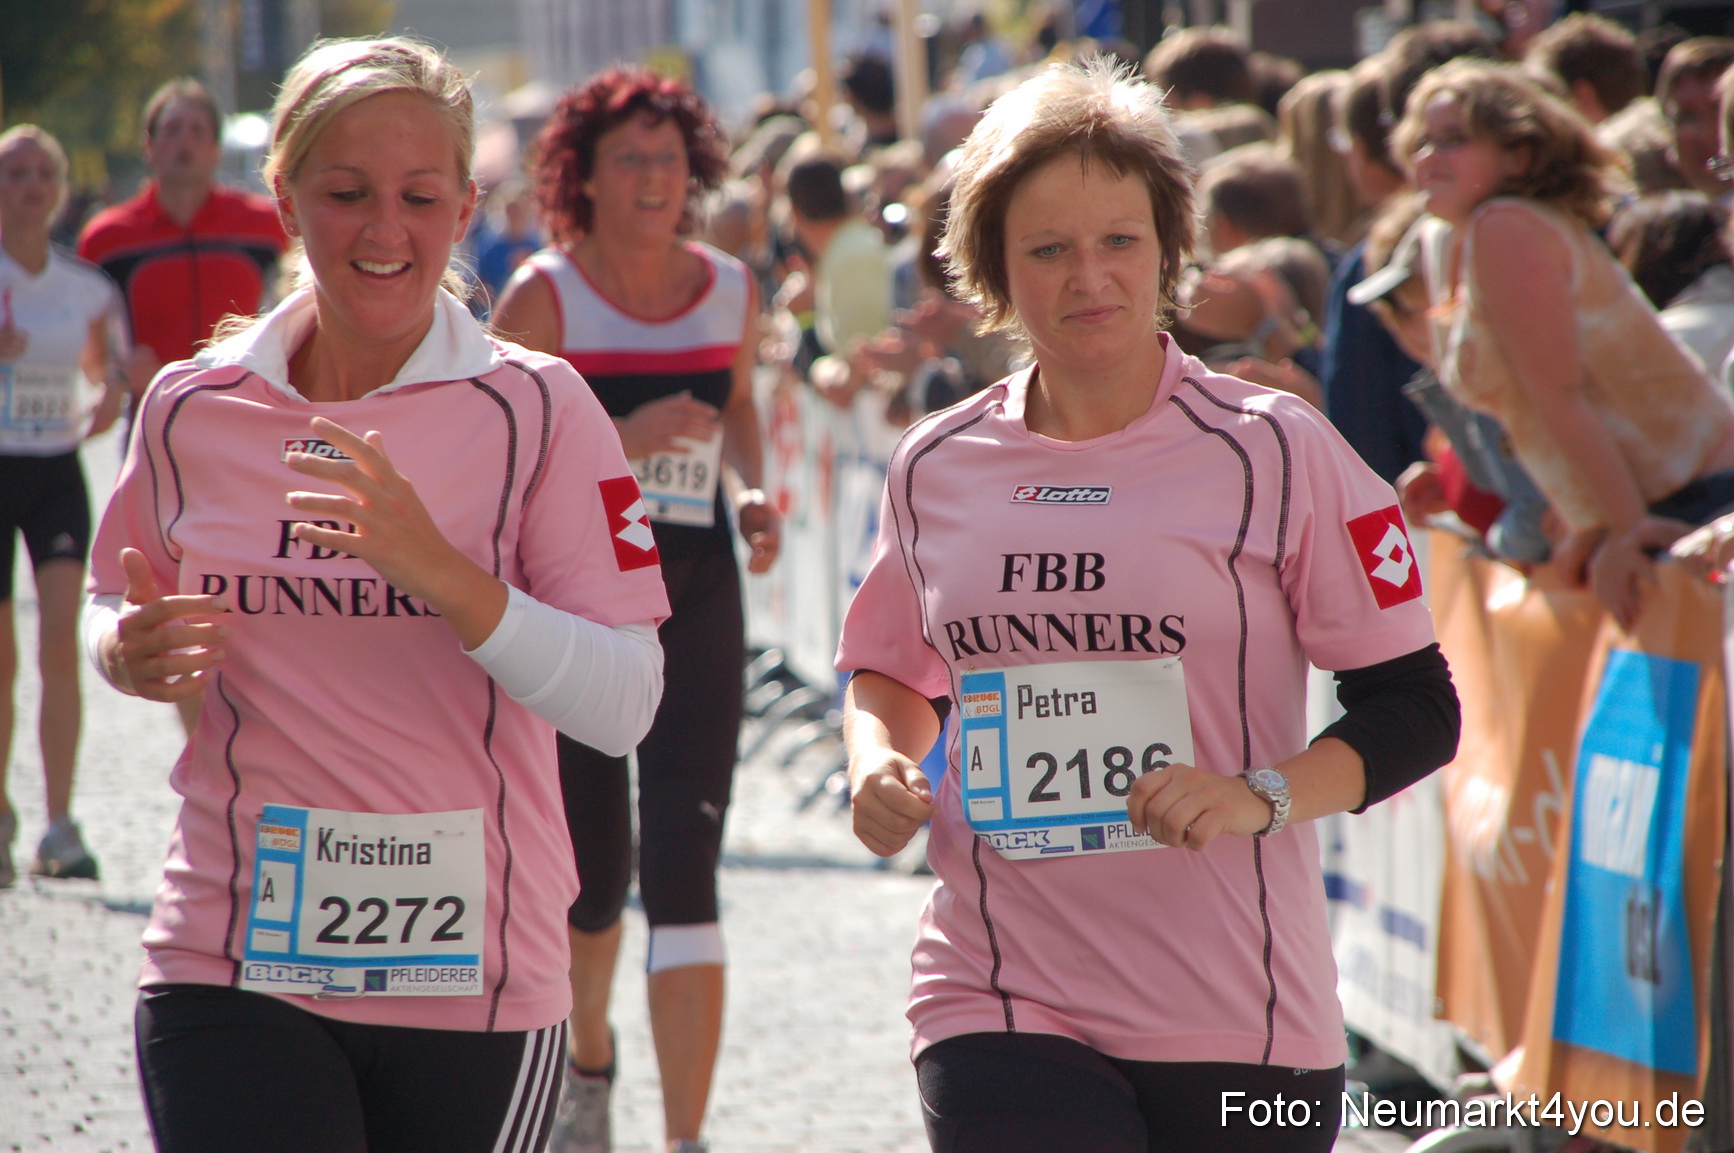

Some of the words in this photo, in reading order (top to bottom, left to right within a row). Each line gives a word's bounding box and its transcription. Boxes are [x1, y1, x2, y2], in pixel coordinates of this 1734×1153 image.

[272, 519, 358, 560] FB
[998, 552, 1106, 593] FBB
[200, 574, 442, 617] RUNNER
[943, 613, 1187, 661] RUNNERS
[1017, 684, 1097, 719] Petra
[971, 746, 983, 771] A
[317, 827, 432, 866] Kristina
[261, 877, 275, 902] A
[316, 895, 465, 944] 2272
[246, 964, 334, 985] BOCK
[390, 967, 478, 983] PFLEIDERER
